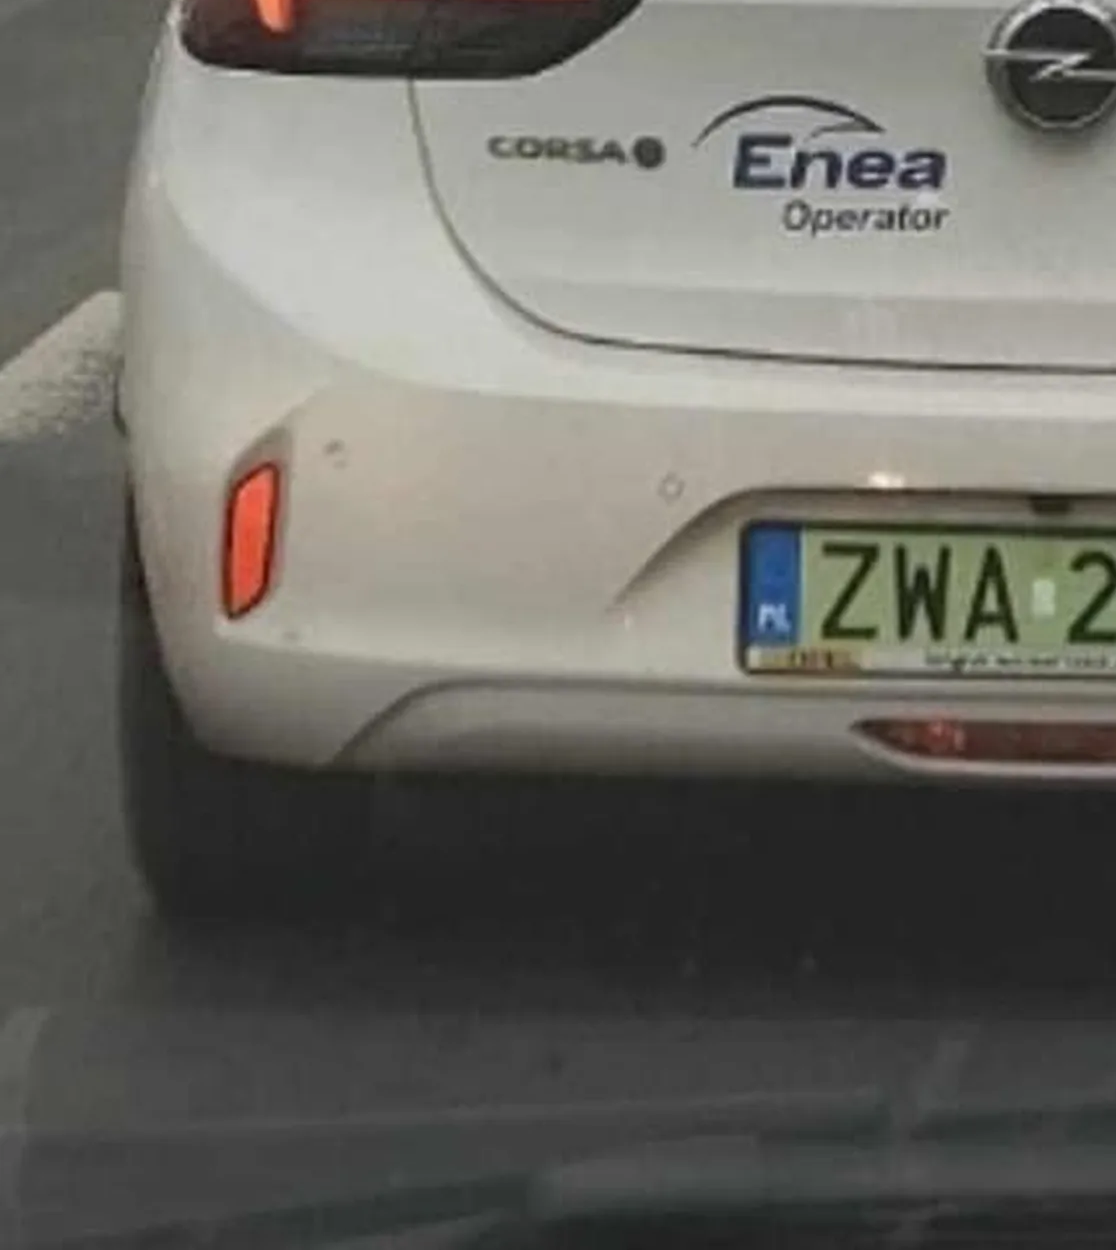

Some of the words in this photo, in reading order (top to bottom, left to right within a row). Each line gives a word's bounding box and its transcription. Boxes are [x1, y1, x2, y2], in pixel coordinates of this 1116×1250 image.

[487, 135, 630, 166] CORSA
[733, 133, 948, 190] Enea
[782, 199, 950, 236] Operator
[820, 541, 1019, 644] ZWA
[758, 604, 791, 632] PL
